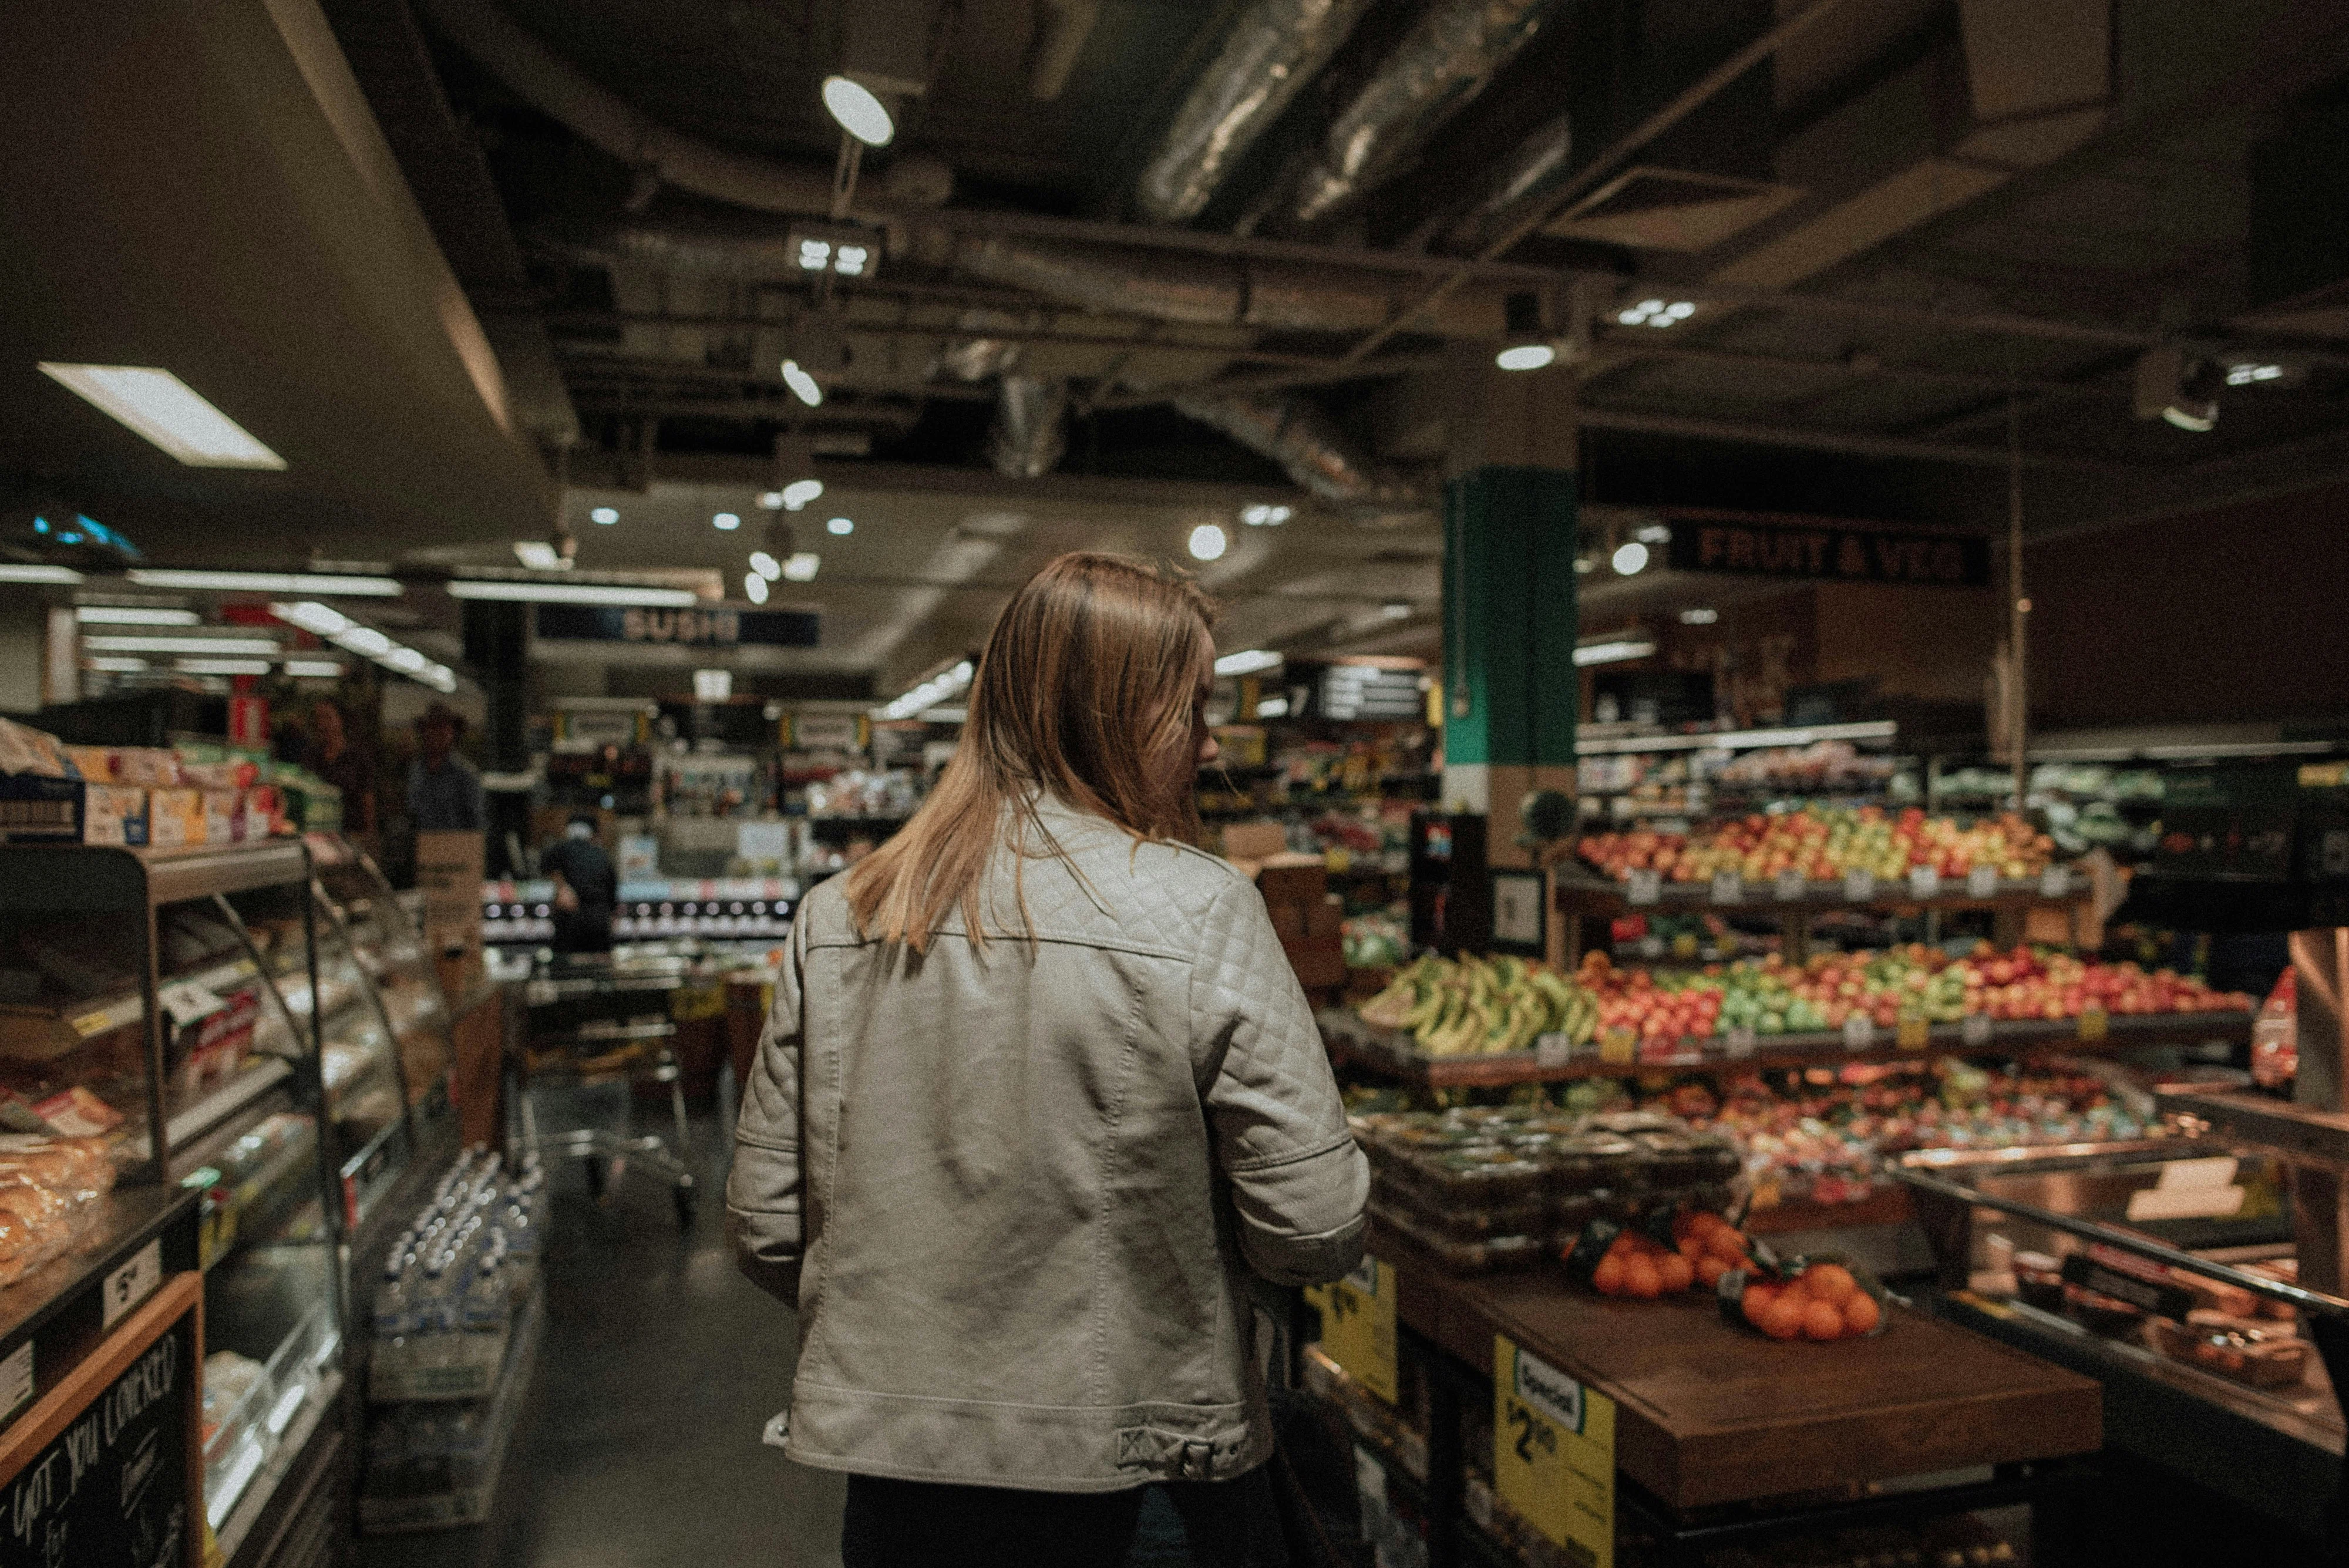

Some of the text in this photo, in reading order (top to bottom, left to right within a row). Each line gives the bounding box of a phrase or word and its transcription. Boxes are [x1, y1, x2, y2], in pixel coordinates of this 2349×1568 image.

[1697, 527, 1830, 574] FRUIT
[1876, 536, 1965, 581] VEG
[623, 608, 740, 642] SUSHI
